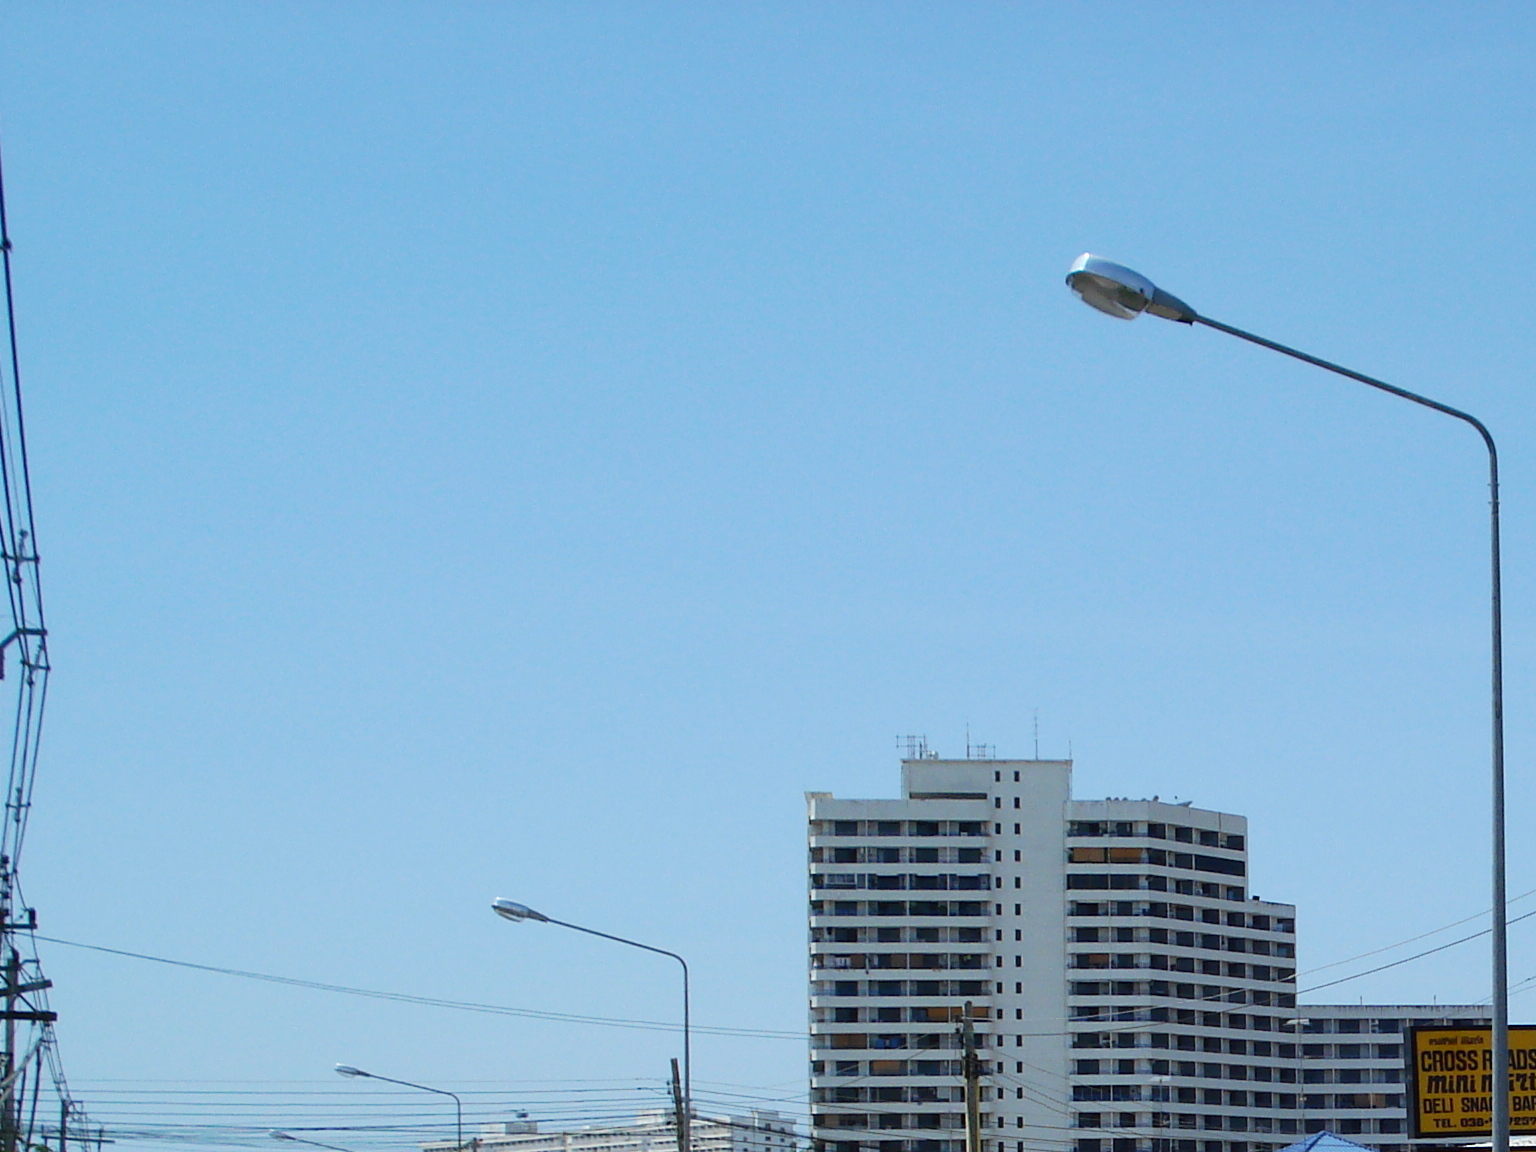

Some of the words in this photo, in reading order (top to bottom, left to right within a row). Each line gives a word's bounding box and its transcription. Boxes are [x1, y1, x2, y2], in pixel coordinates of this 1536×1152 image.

[1421, 1050, 1478, 1072] CROSS
[1427, 1073, 1476, 1094] mini
[1423, 1098, 1454, 1114] DELI
[1461, 1097, 1492, 1114] SNA
[1433, 1118, 1457, 1128] TEL.
